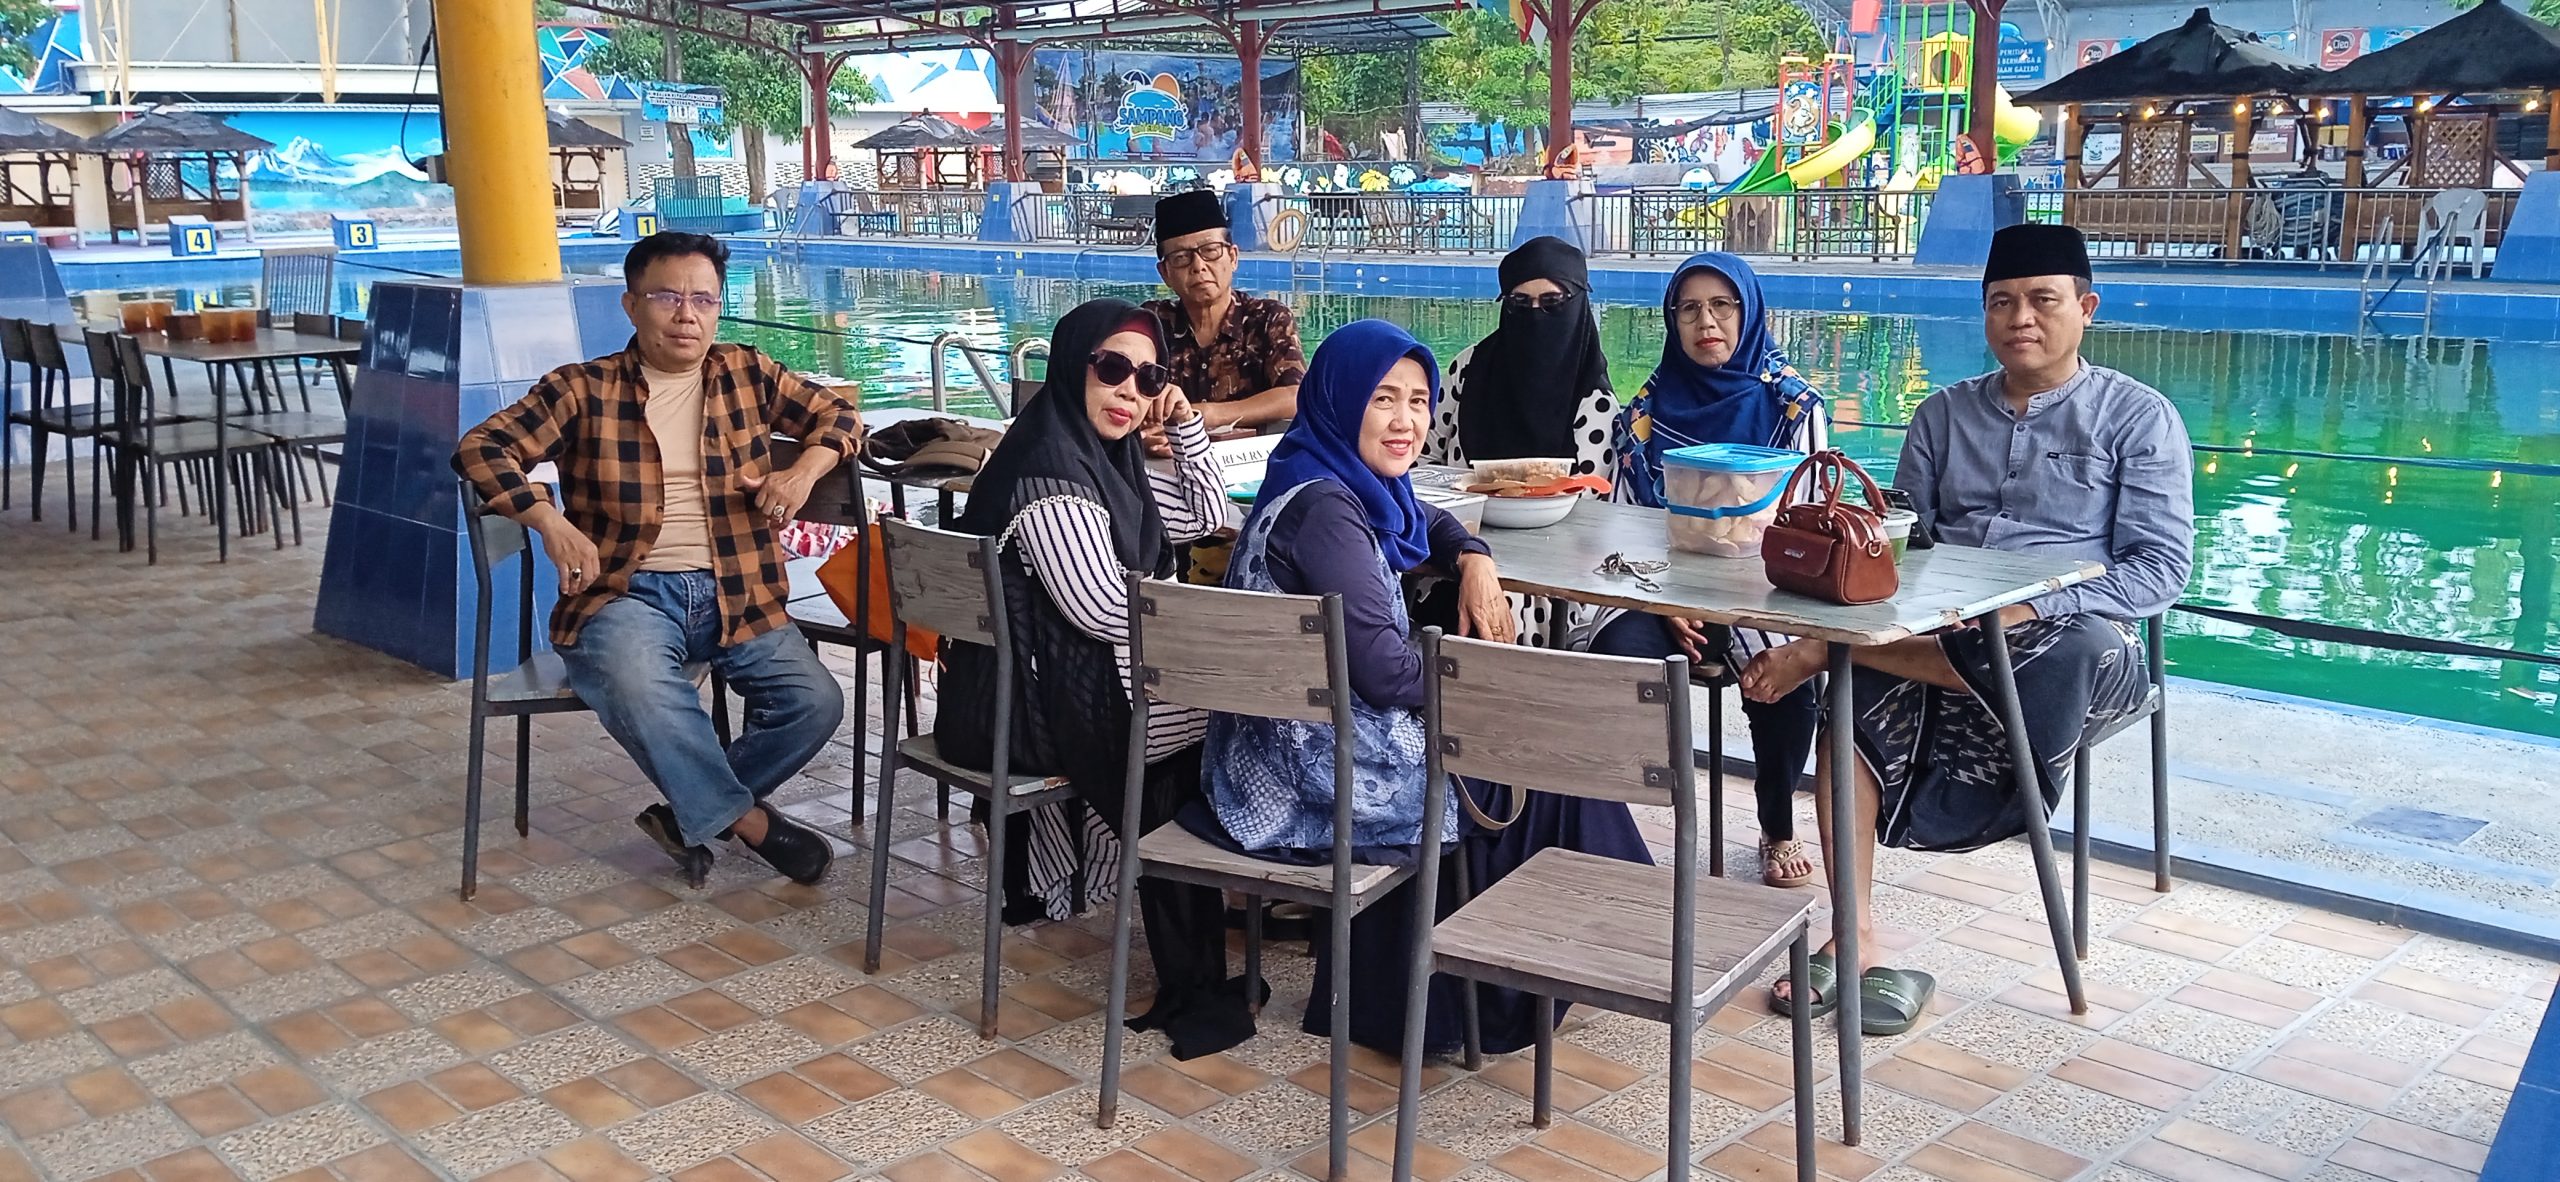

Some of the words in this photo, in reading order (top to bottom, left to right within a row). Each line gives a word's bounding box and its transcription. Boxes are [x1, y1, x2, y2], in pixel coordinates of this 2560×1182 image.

[2332, 39, 2349, 49] Cleo
[1119, 107, 1184, 127] SAMPANG
[356, 226, 367, 243] 3
[643, 218, 650, 234] 1
[194, 232, 205, 249] 4
